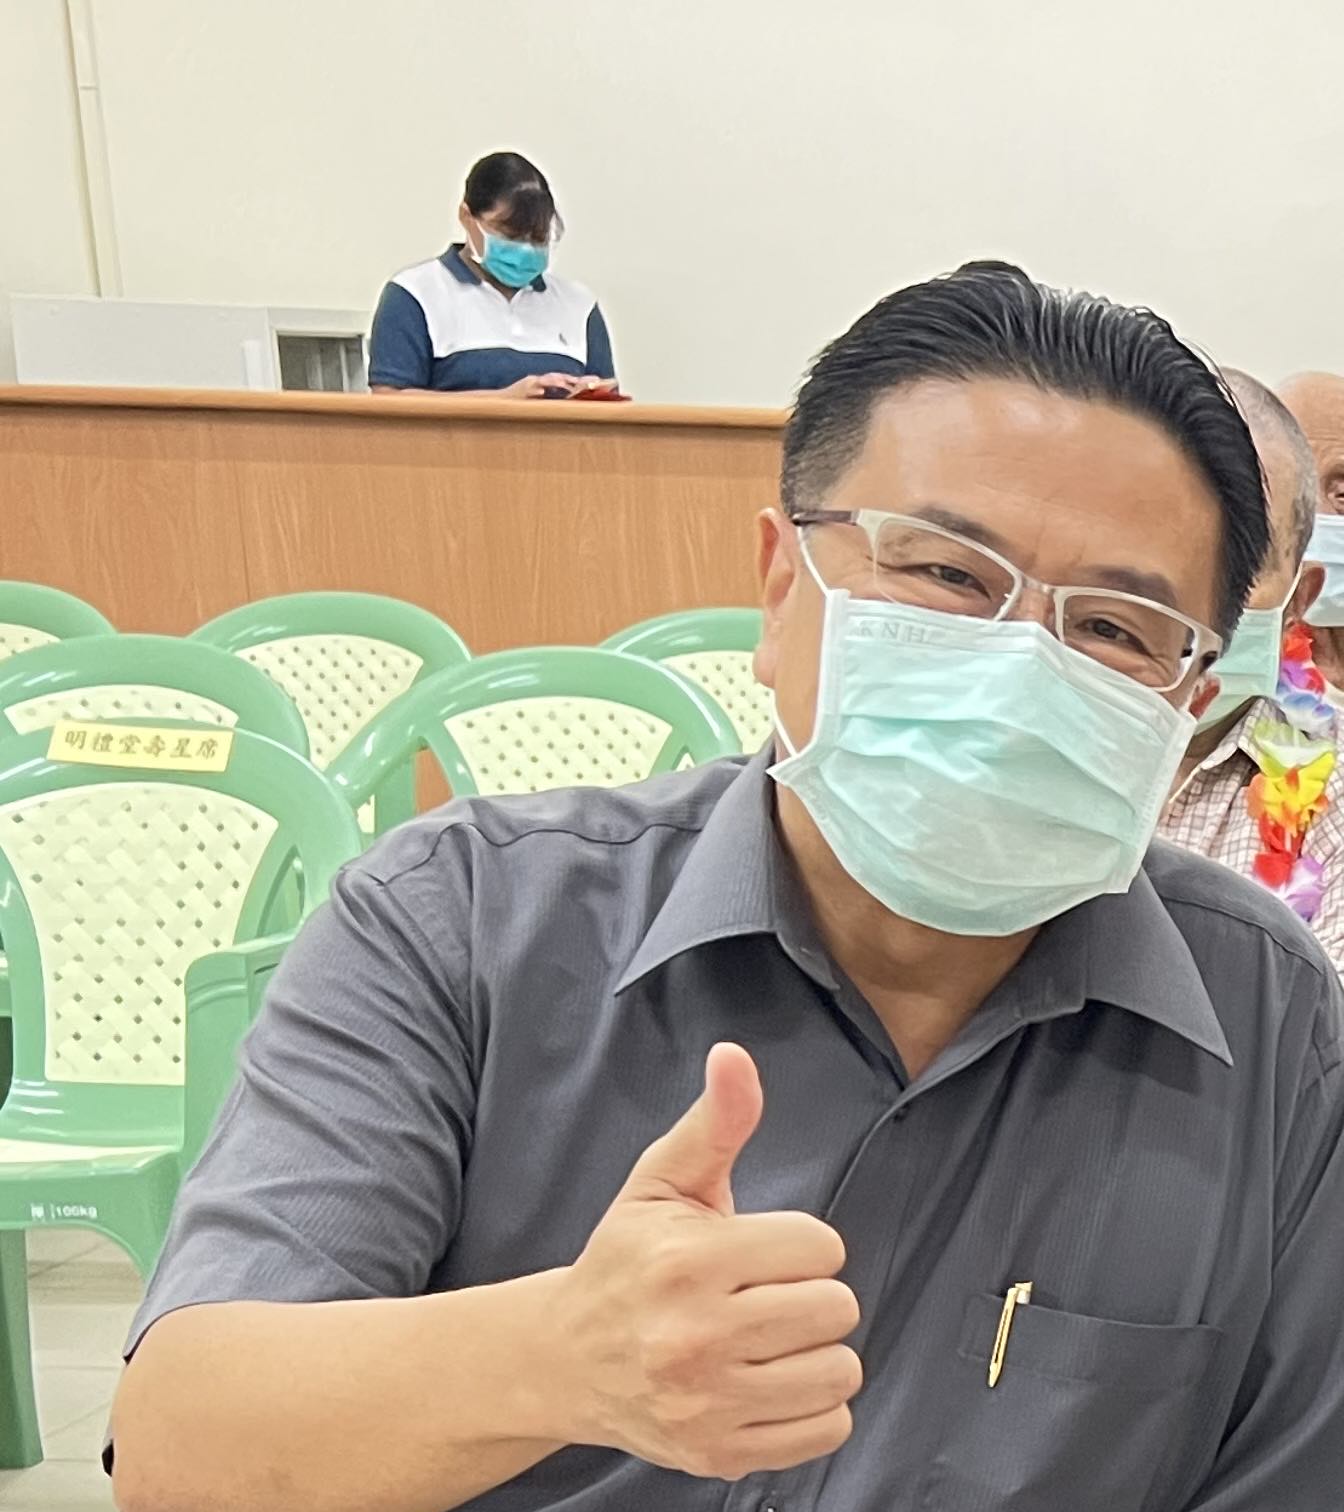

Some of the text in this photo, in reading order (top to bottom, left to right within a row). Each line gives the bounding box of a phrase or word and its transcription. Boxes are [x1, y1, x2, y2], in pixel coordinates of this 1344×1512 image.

[64, 730, 219, 760] 明禮堂壽星席
